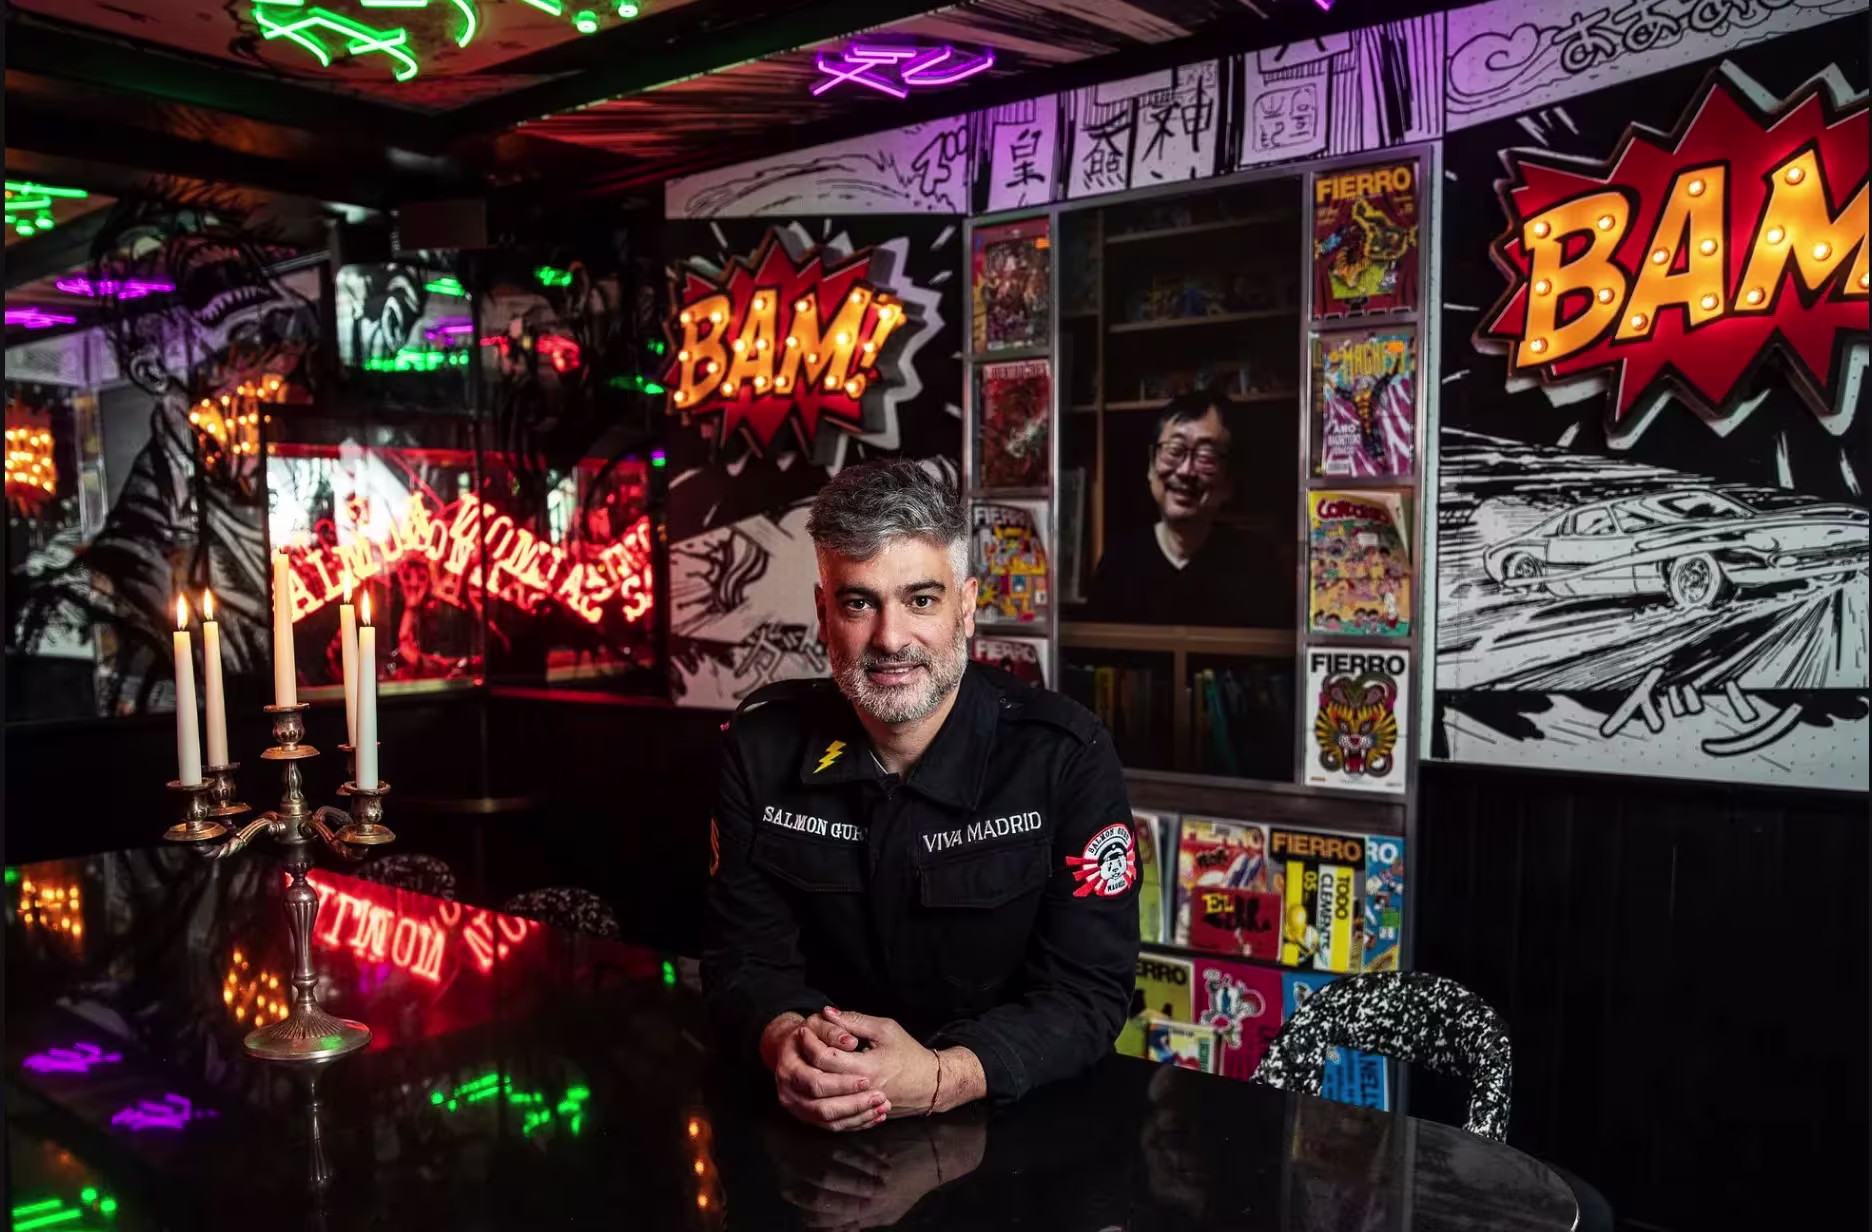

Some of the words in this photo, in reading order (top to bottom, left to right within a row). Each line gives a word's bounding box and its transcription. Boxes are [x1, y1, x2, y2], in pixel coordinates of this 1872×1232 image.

[1316, 167, 1411, 203] FIERRO
[1516, 148, 1870, 368] BAM
[674, 286, 907, 410] BAM!
[1310, 653, 1405, 676] FIERRO
[762, 805, 829, 836] SALMON
[831, 822, 868, 842] GUR
[922, 829, 963, 853] VIVA
[967, 811, 1042, 843] MADRID
[1273, 831, 1362, 862] FIERRO
